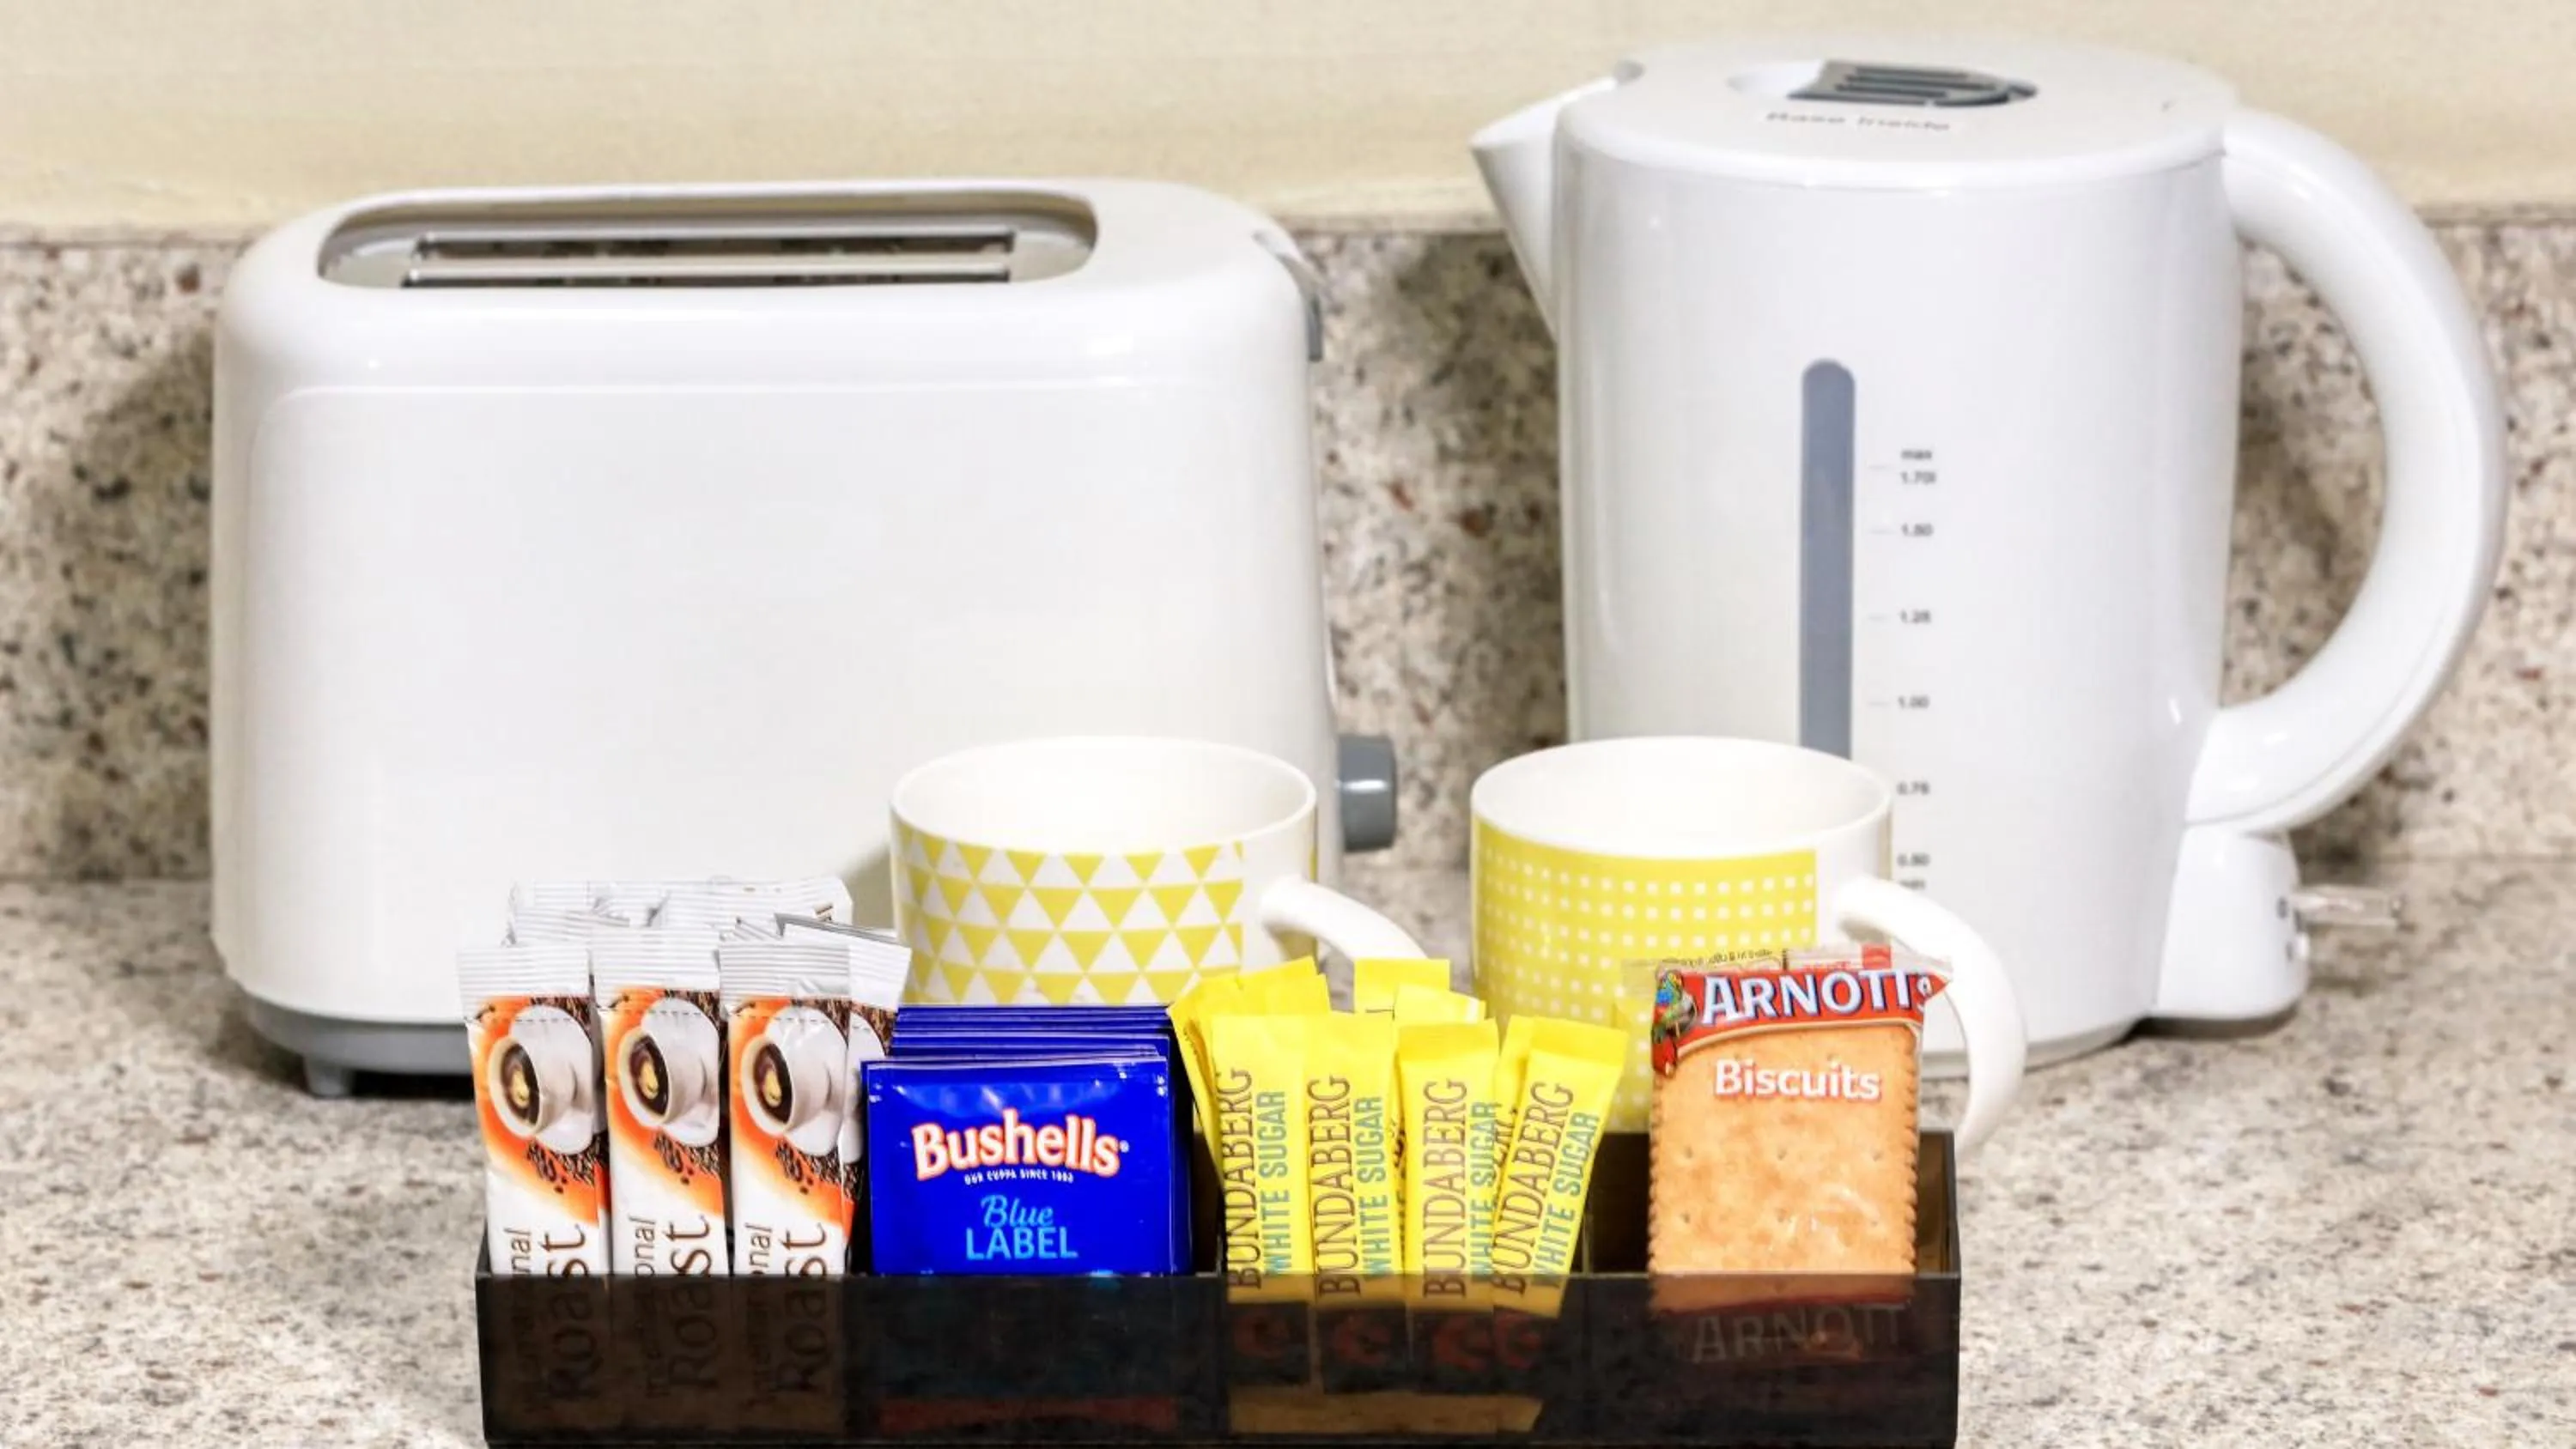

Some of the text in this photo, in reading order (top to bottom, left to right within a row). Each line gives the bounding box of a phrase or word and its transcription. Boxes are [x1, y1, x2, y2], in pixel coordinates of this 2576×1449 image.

[911, 1106, 1121, 1182] Bushells
[1471, 1100, 1497, 1188] SUGAR
[1715, 1058, 1881, 1101] Biscuits
[981, 1194, 1054, 1228] Blue
[1217, 1068, 1261, 1289] BUNDABERG
[1256, 1091, 1292, 1277] WHITE SUGAR
[1307, 1075, 1362, 1297] BUNDABERG
[1354, 1096, 1392, 1279] WHITE SUGAR
[1423, 1078, 1467, 1298] BUNDABERG
[1492, 1081, 1575, 1296] BUNDABERG
[1552, 1111, 1601, 1197] SUGAR
[965, 1226, 1079, 1260] LABEL
